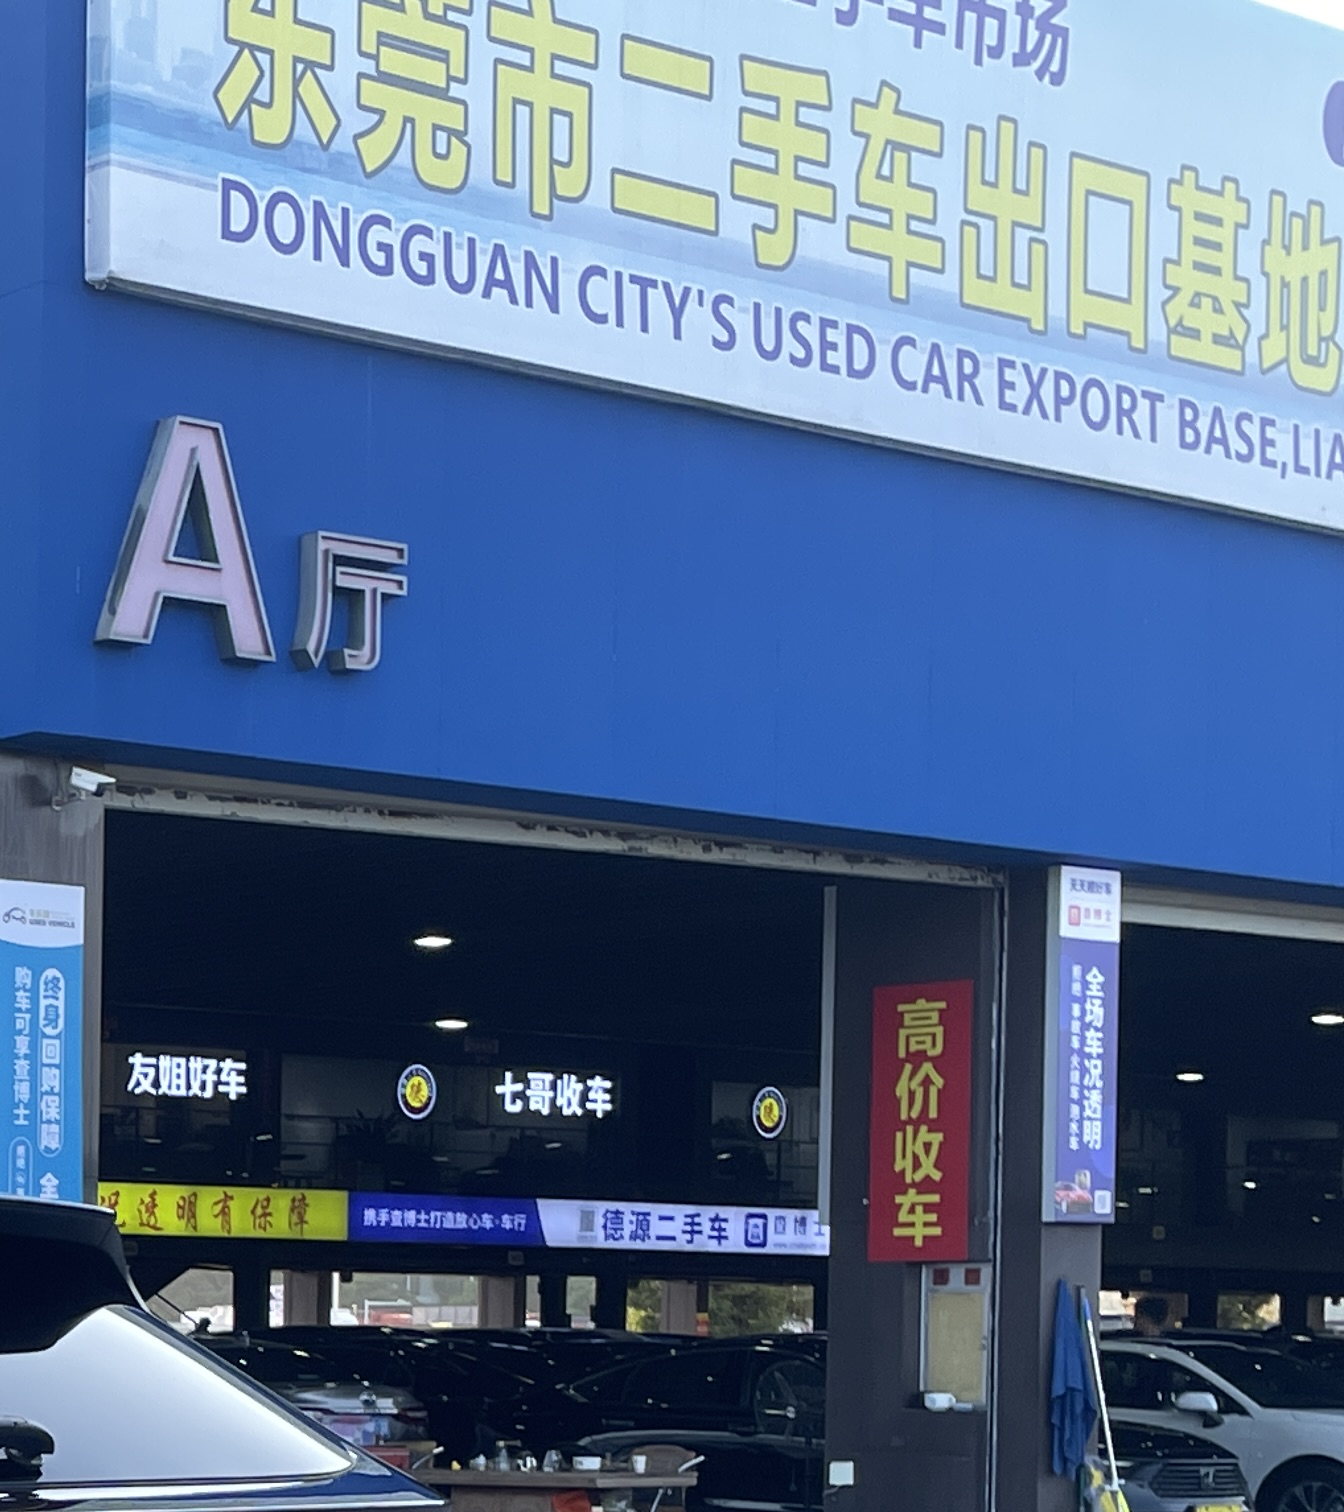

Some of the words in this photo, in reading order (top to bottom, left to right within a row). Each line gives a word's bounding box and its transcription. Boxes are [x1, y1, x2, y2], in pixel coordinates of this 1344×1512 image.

[213, 0, 1342, 396] 东莞市二手车出口基地
[220, 177, 560, 315] DONGGUAN
[577, 264, 736, 352] CITY'S
[752, 301, 876, 380] USED
[890, 335, 984, 407] CAR
[996, 358, 1164, 443] EXPORT
[13, 966, 32, 1126] 购车可享查博士
[42, 973, 62, 1031] 终身
[1082, 966, 1106, 1151] 全场车况透明
[40, 1038, 61, 1151] 回购保障
[127, 1052, 248, 1100] 友姐好车
[495, 1071, 613, 1119] 七哥收车
[892, 998, 947, 1248] 高价收车
[601, 1208, 729, 1247] 德源二手车
